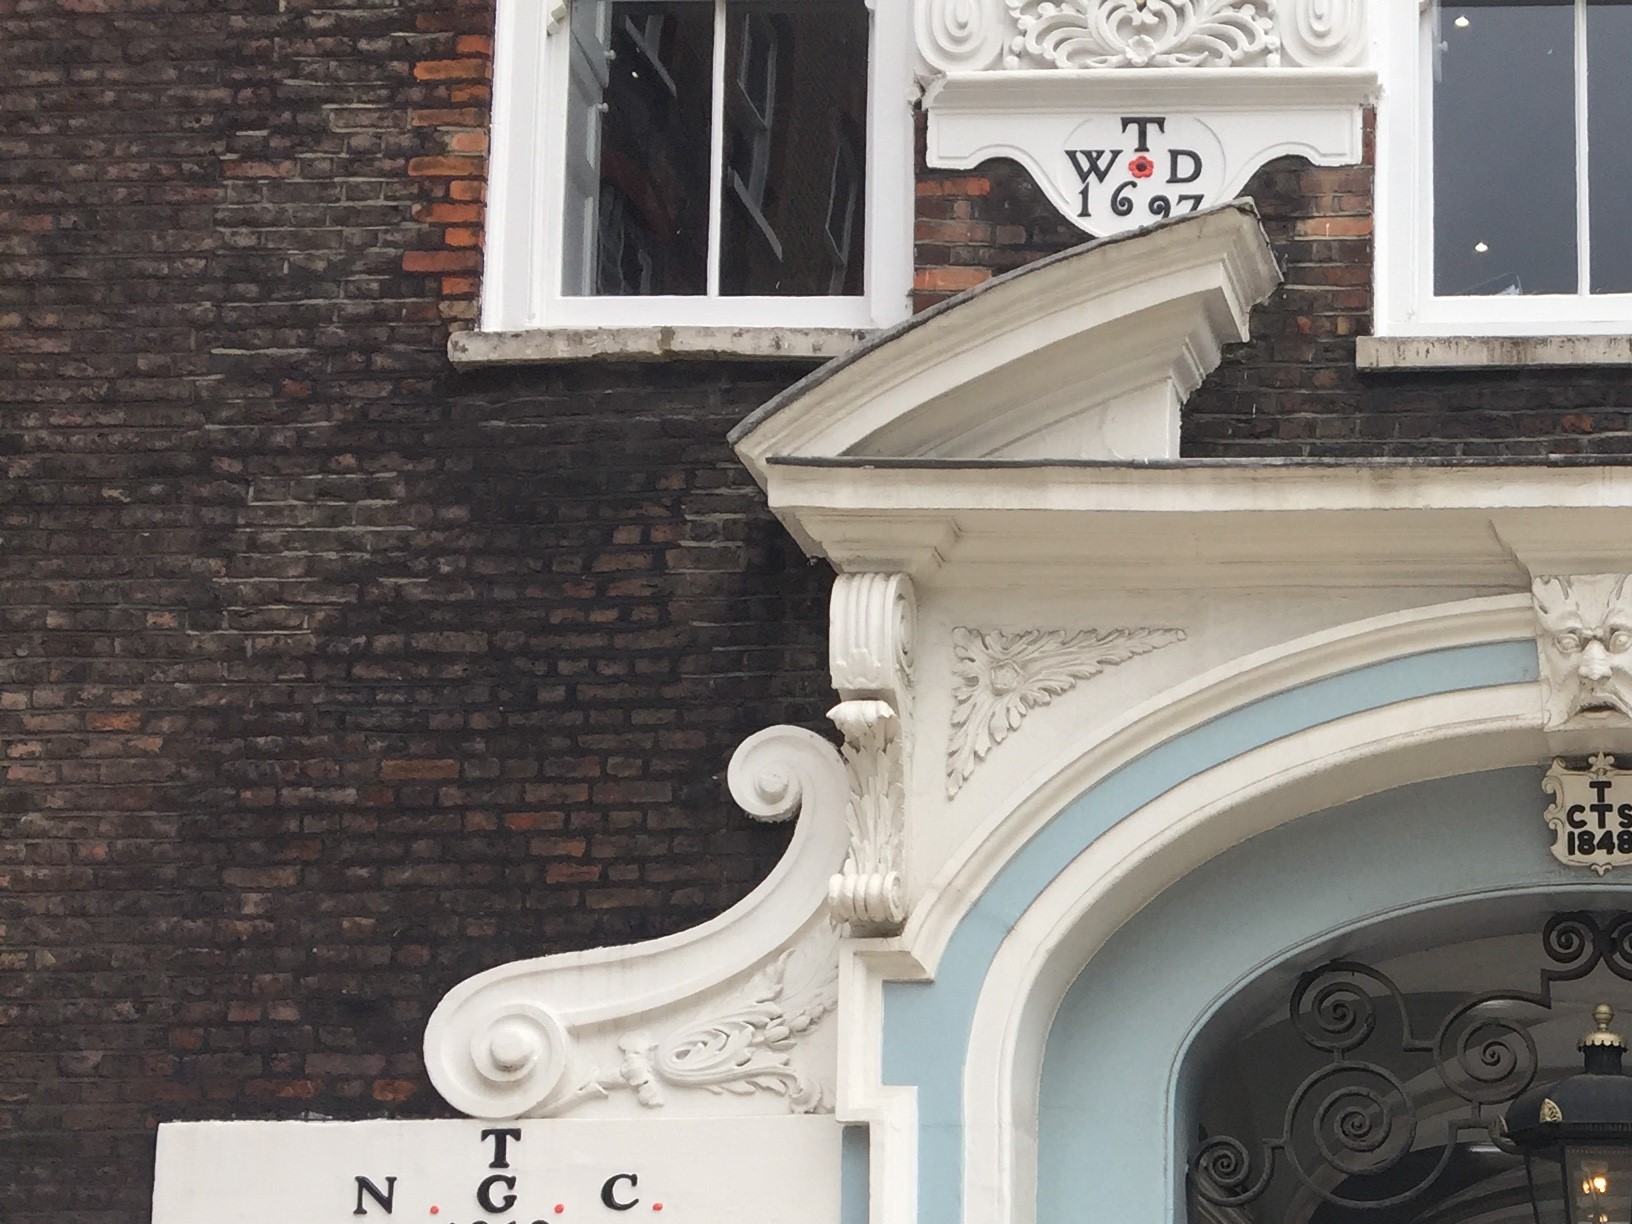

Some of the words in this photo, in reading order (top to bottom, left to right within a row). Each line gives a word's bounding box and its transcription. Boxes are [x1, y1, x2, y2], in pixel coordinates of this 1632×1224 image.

[1120, 117, 1166, 152] T
[1064, 150, 1123, 184] W
[1166, 149, 1203, 183] D
[1589, 781, 1612, 803] T
[481, 1128, 521, 1168] T
